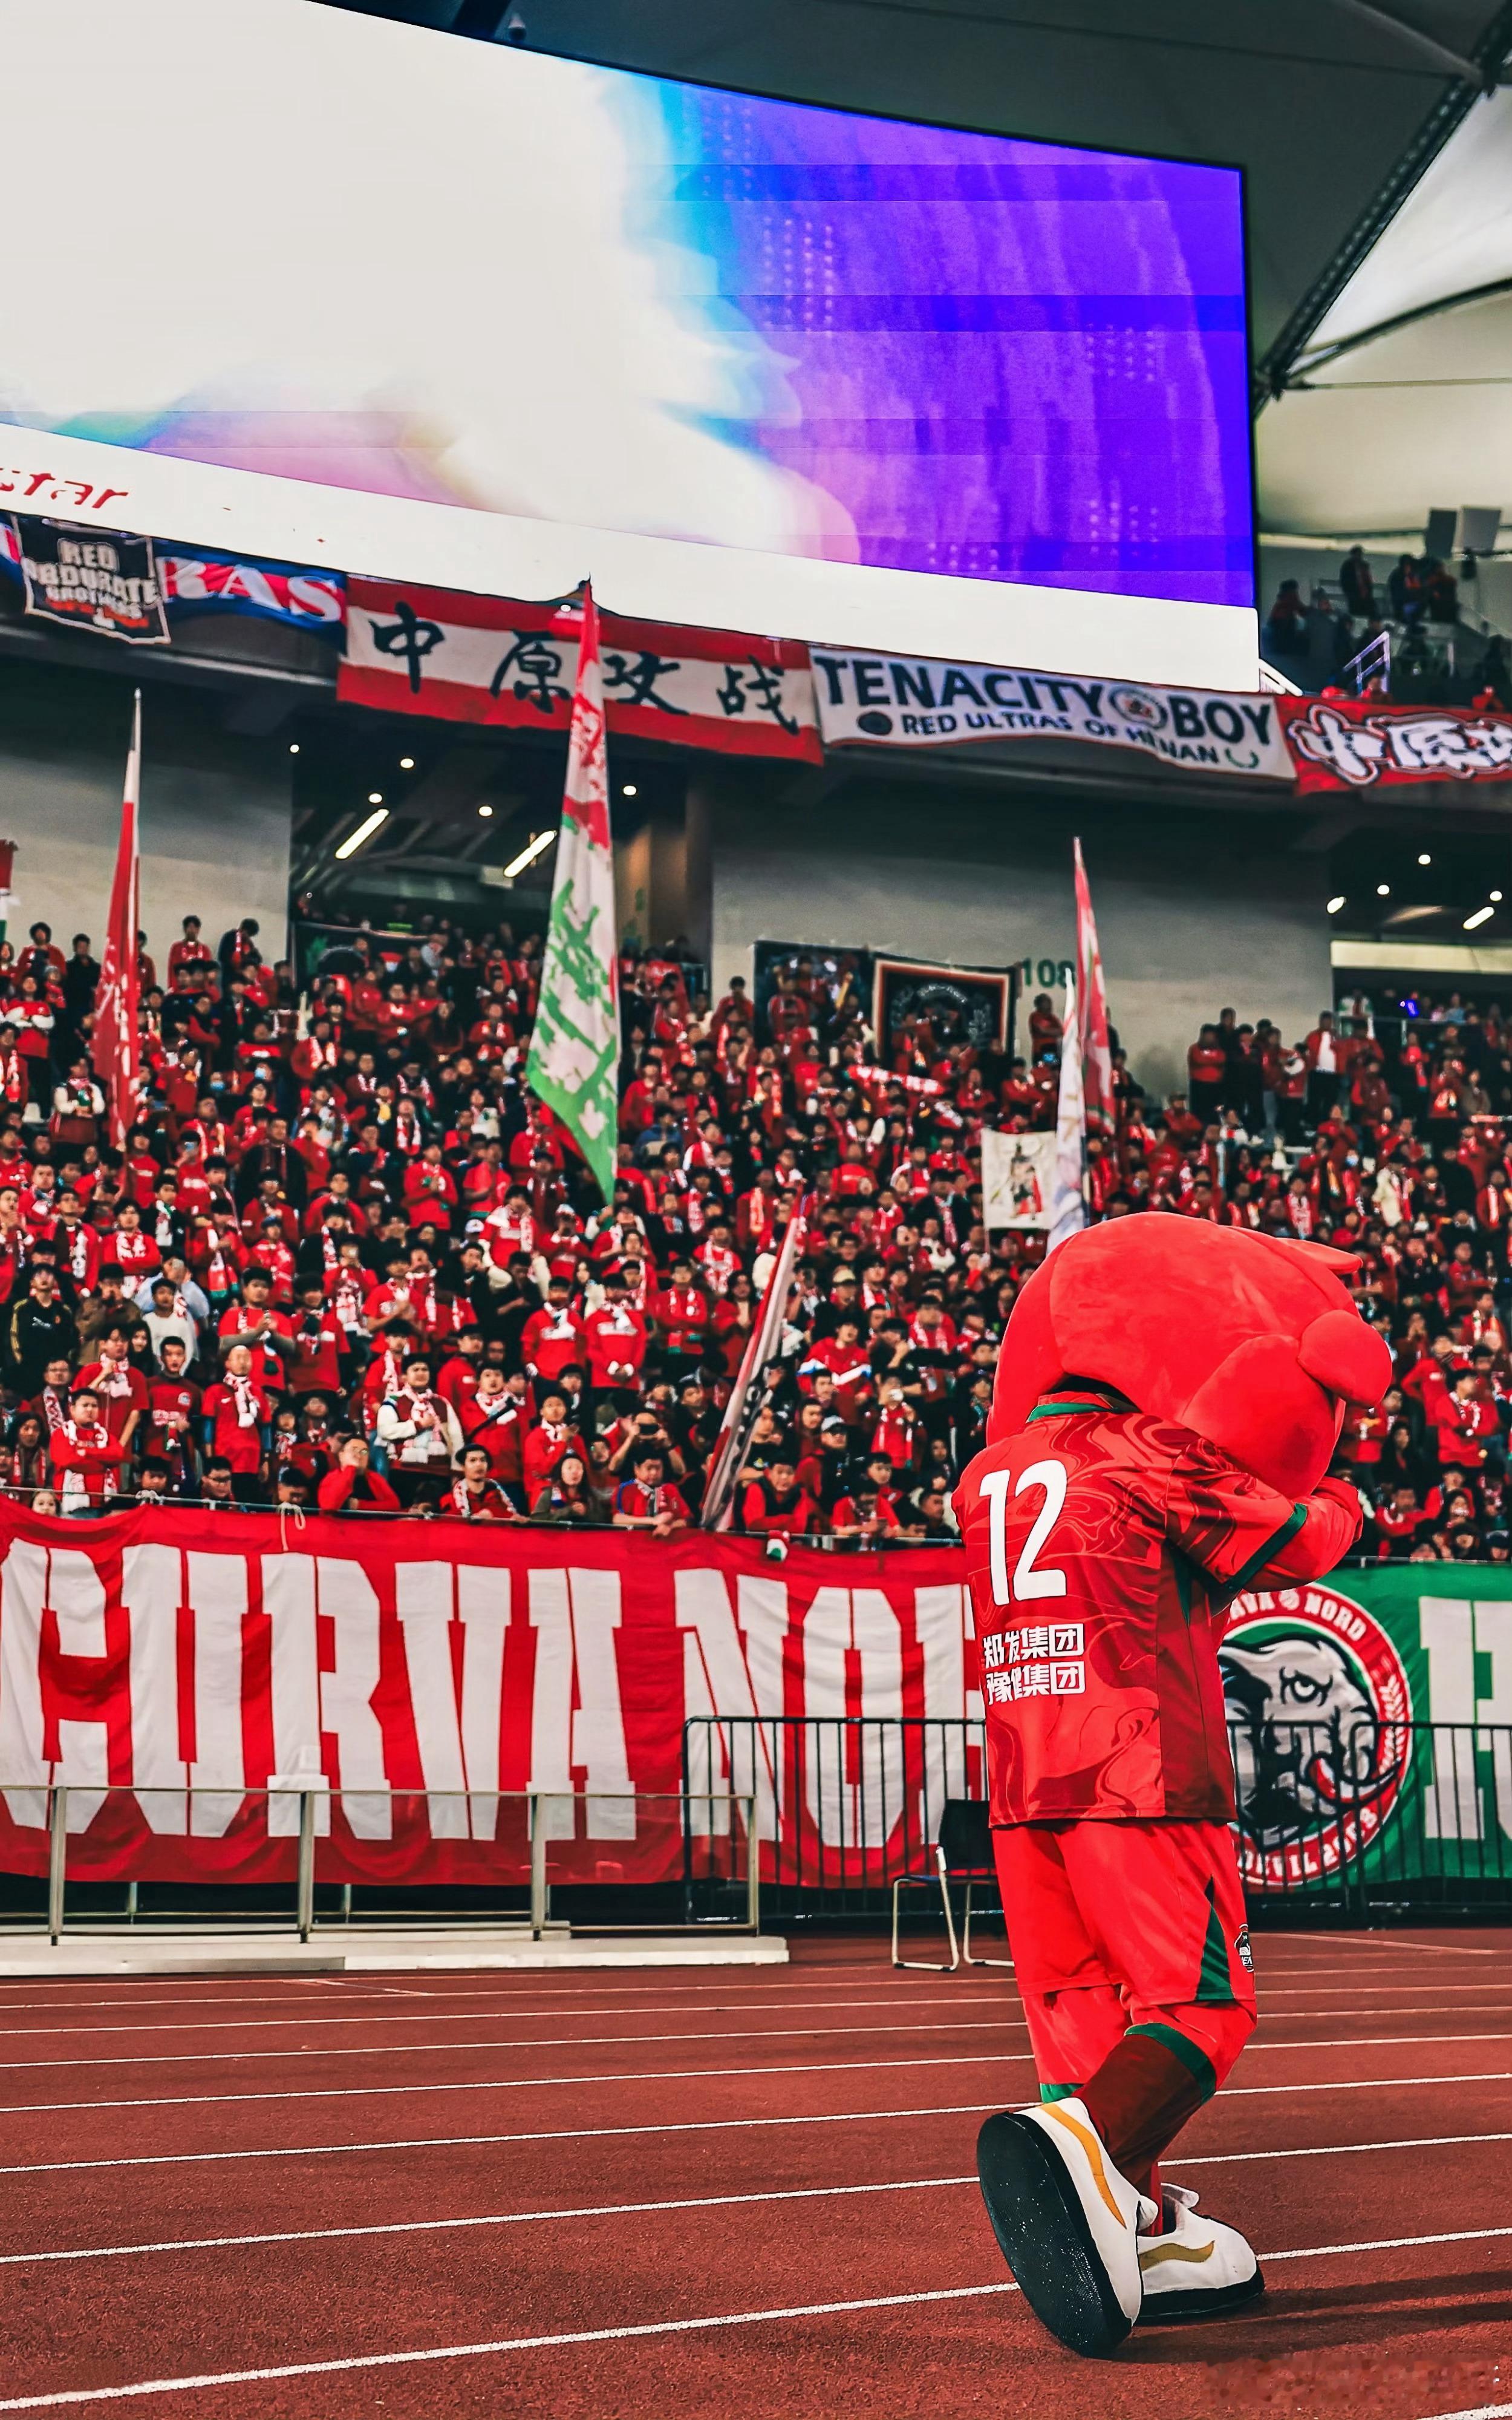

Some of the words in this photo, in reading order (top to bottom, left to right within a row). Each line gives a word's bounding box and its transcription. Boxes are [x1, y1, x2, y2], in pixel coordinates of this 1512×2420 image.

[60, 540, 117, 571] RED
[813, 656, 1103, 717] TENACITY
[1167, 695, 1270, 745] BOY
[901, 714, 957, 735] RED
[964, 711, 1072, 730] ULTRAS
[1084, 719, 1116, 737] OF
[979, 1459, 1067, 1606] 12
[1304, 1592, 1367, 1641] NORD
[983, 1623, 1084, 1669] 郑发集团
[0, 1537, 636, 1841] CURVA
